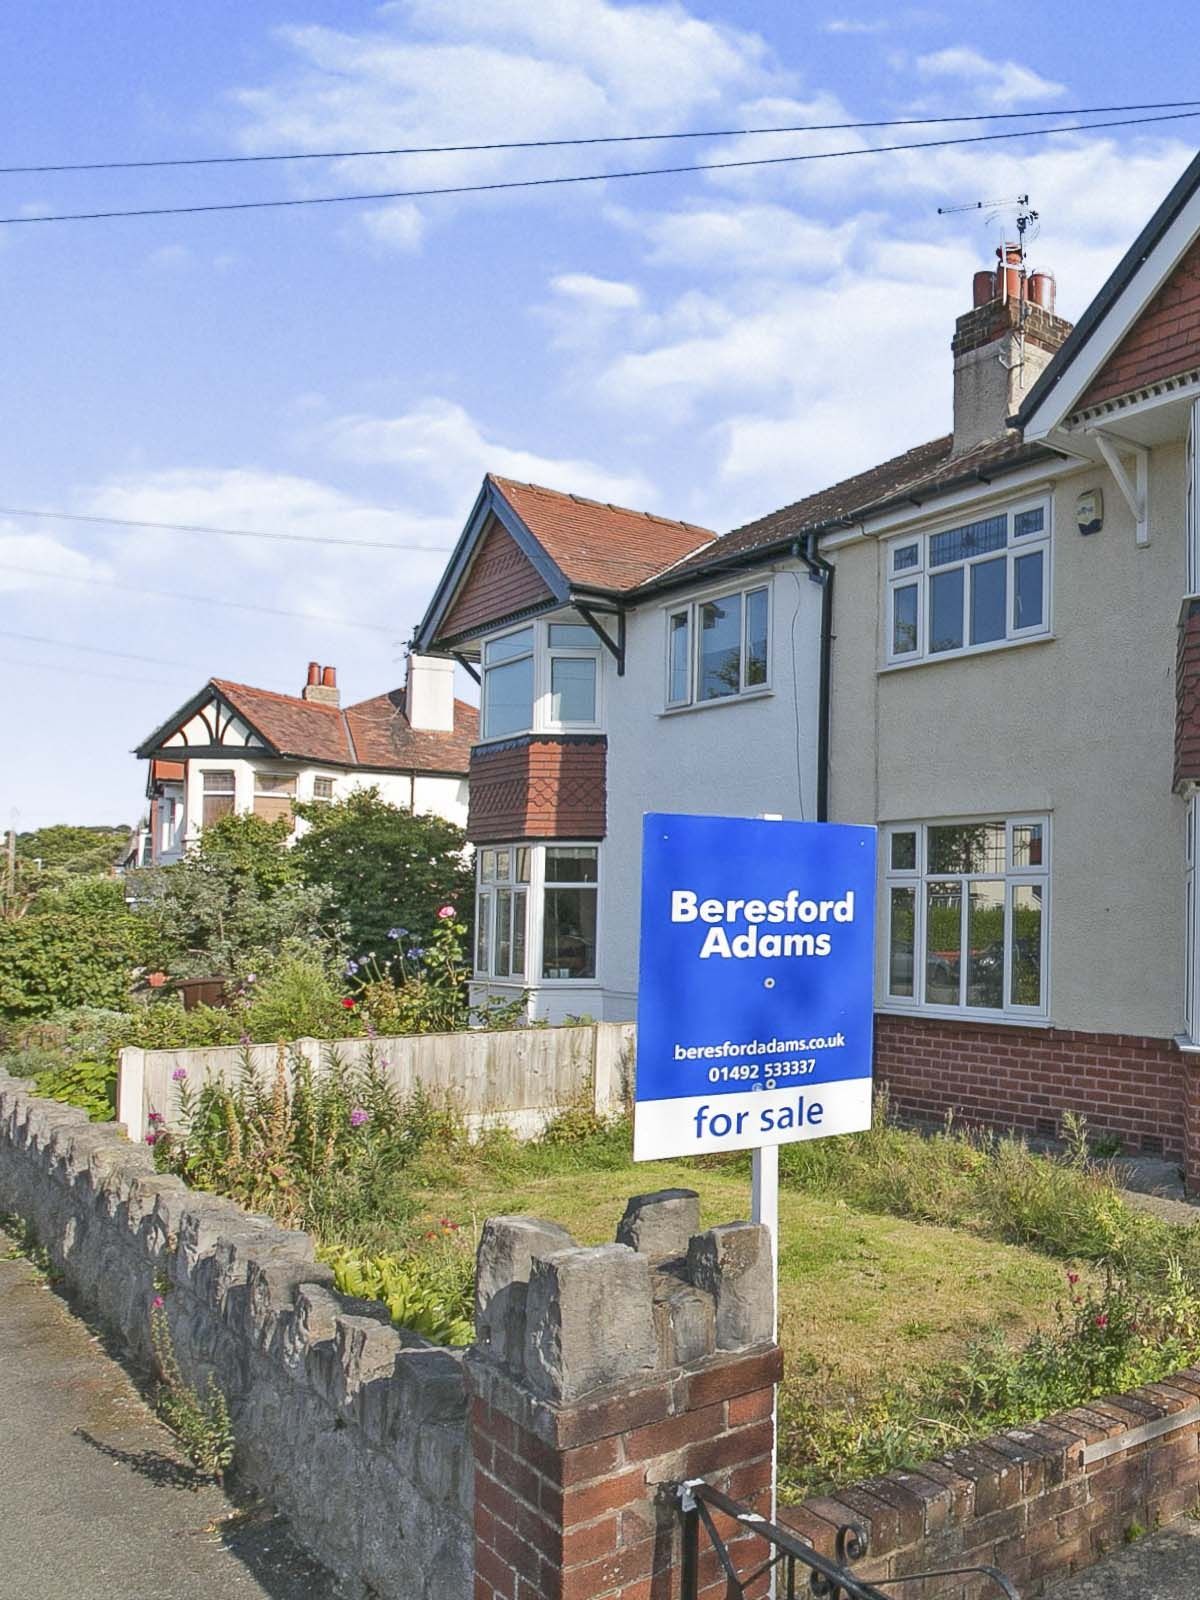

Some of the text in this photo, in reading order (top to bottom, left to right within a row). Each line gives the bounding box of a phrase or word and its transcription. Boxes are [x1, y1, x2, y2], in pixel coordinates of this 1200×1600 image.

[671, 890, 854, 923] Beresford
[699, 925, 832, 958] Adams
[674, 1032, 845, 1060] beresfordadams.co.uk
[708, 1059, 816, 1082] 01492 533337
[694, 1096, 824, 1138] for sale
